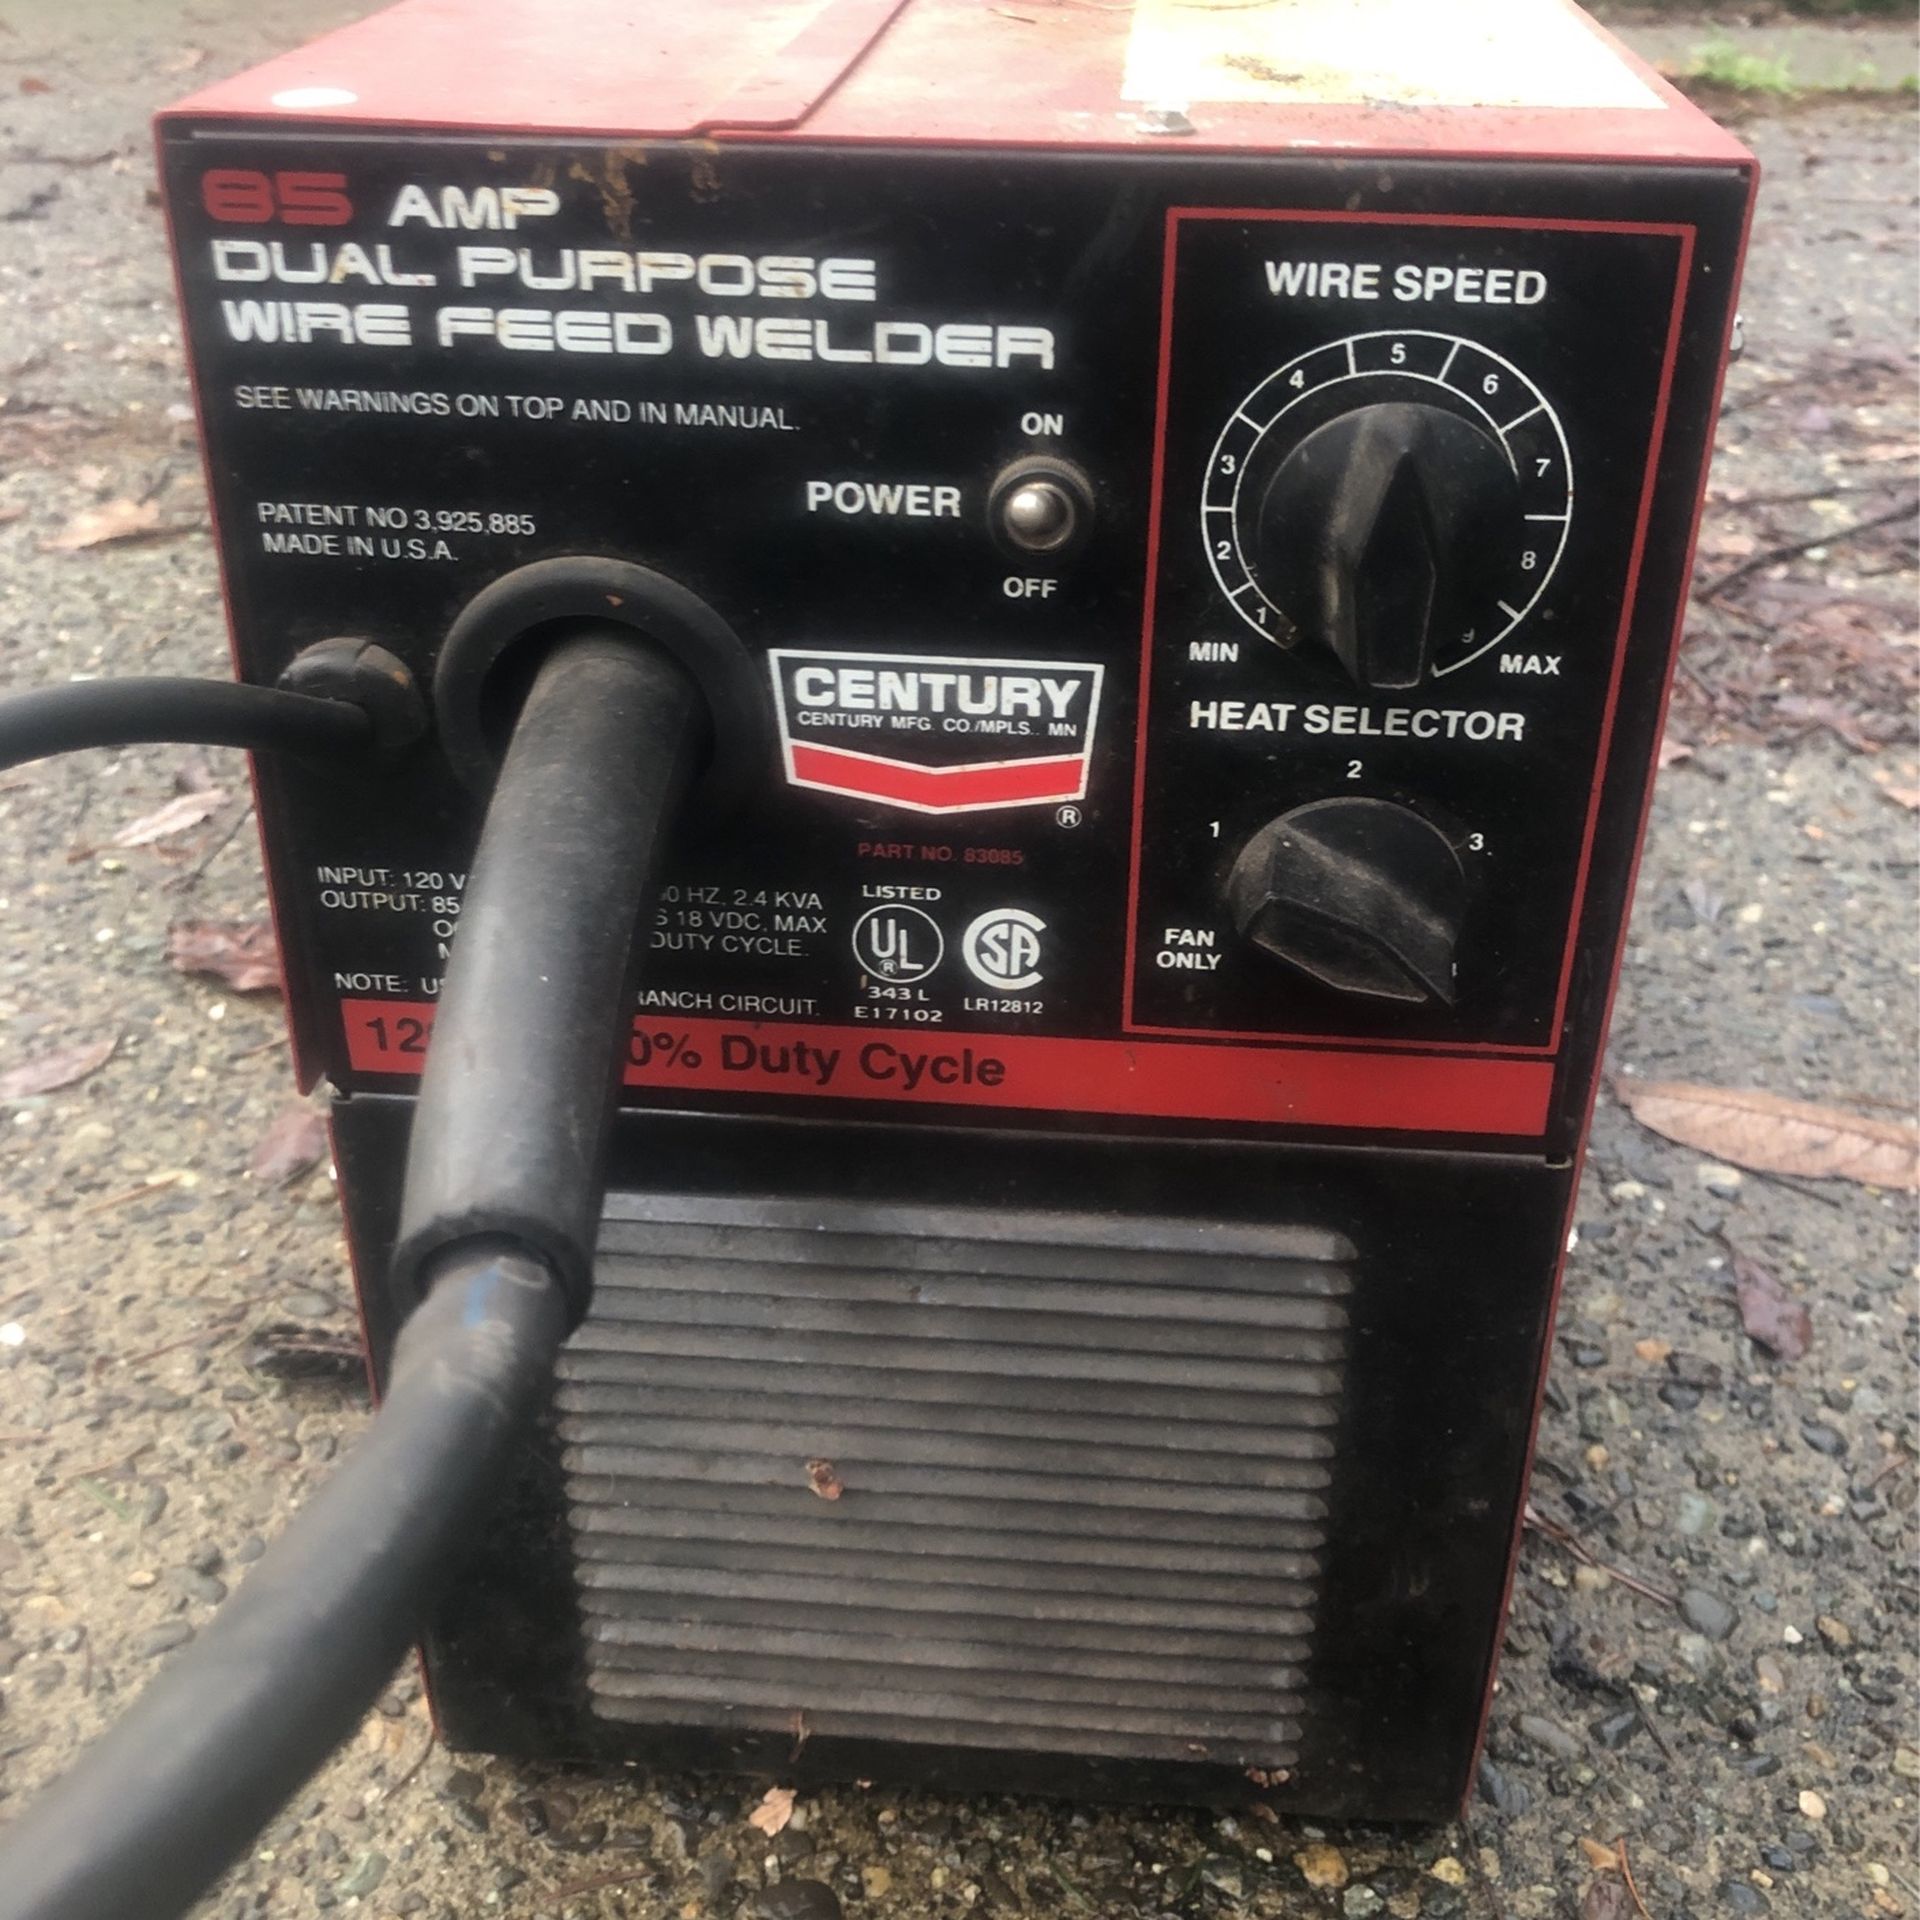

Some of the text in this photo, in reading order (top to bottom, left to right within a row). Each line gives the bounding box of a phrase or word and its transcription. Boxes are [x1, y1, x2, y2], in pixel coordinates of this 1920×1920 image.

[202, 169, 560, 230] 85 AMP
[211, 240, 876, 300] DUAL PURPOSE
[1264, 261, 1547, 305] WIRE SPEED
[222, 300, 1055, 370] WIRE FEED WELDER
[1390, 344, 1406, 364] 5
[1289, 370, 1304, 389] 4
[1482, 374, 1499, 395] 6
[234, 385, 800, 432] SEE WARNINGS ON TOP AND IN MANUAL.
[1020, 413, 1064, 436] ON
[1220, 455, 1236, 475] 3
[1536, 458, 1551, 477] 7
[806, 481, 962, 518] POWER
[257, 502, 359, 528] PATENT
[365, 506, 408, 530] NO
[262, 532, 460, 561] MADE IN U.S.A.
[1216, 541, 1231, 560] 2
[1520, 551, 1537, 570] 8
[1003, 577, 1058, 599] OFF
[1257, 606, 1267, 625] 1
[1188, 641, 1239, 664] MIN
[1499, 654, 1562, 676] MAX
[793, 666, 1081, 719] CENTURY
[797, 711, 883, 729] CENTURY
[891, 716, 935, 732] MFG.
[1048, 724, 1077, 737] MN
[1189, 700, 1526, 742] HEAT SELECTOR
[1347, 760, 1362, 779] 2
[1208, 821, 1221, 838] 1
[857, 842, 914, 859] PART
[1468, 833, 1485, 851] 3
[317, 866, 395, 888] INPUT:
[402, 871, 444, 890] 120
[659, 885, 681, 903] 0
[733, 889, 768, 907] 2.4
[774, 890, 824, 911] KVA
[862, 884, 942, 901] LISTED
[320, 889, 427, 913] OUTPUT:
[431, 895, 462, 915] 85
[676, 910, 704, 928] 18
[773, 914, 828, 934] MAX
[650, 931, 810, 957] DUTY CYCLE.
[1164, 928, 1215, 948] FAN
[1156, 951, 1222, 970] ONLY
[334, 972, 409, 993] NOTE:
[719, 994, 821, 1017] CIRCUIT.
[867, 986, 931, 1001] 343 L
[854, 1006, 943, 1022] E17102
[963, 997, 1044, 1014] LR12812
[365, 1016, 436, 1053] 12
[721, 1034, 840, 1084] Duty
[858, 1042, 1006, 1090] Cycle
